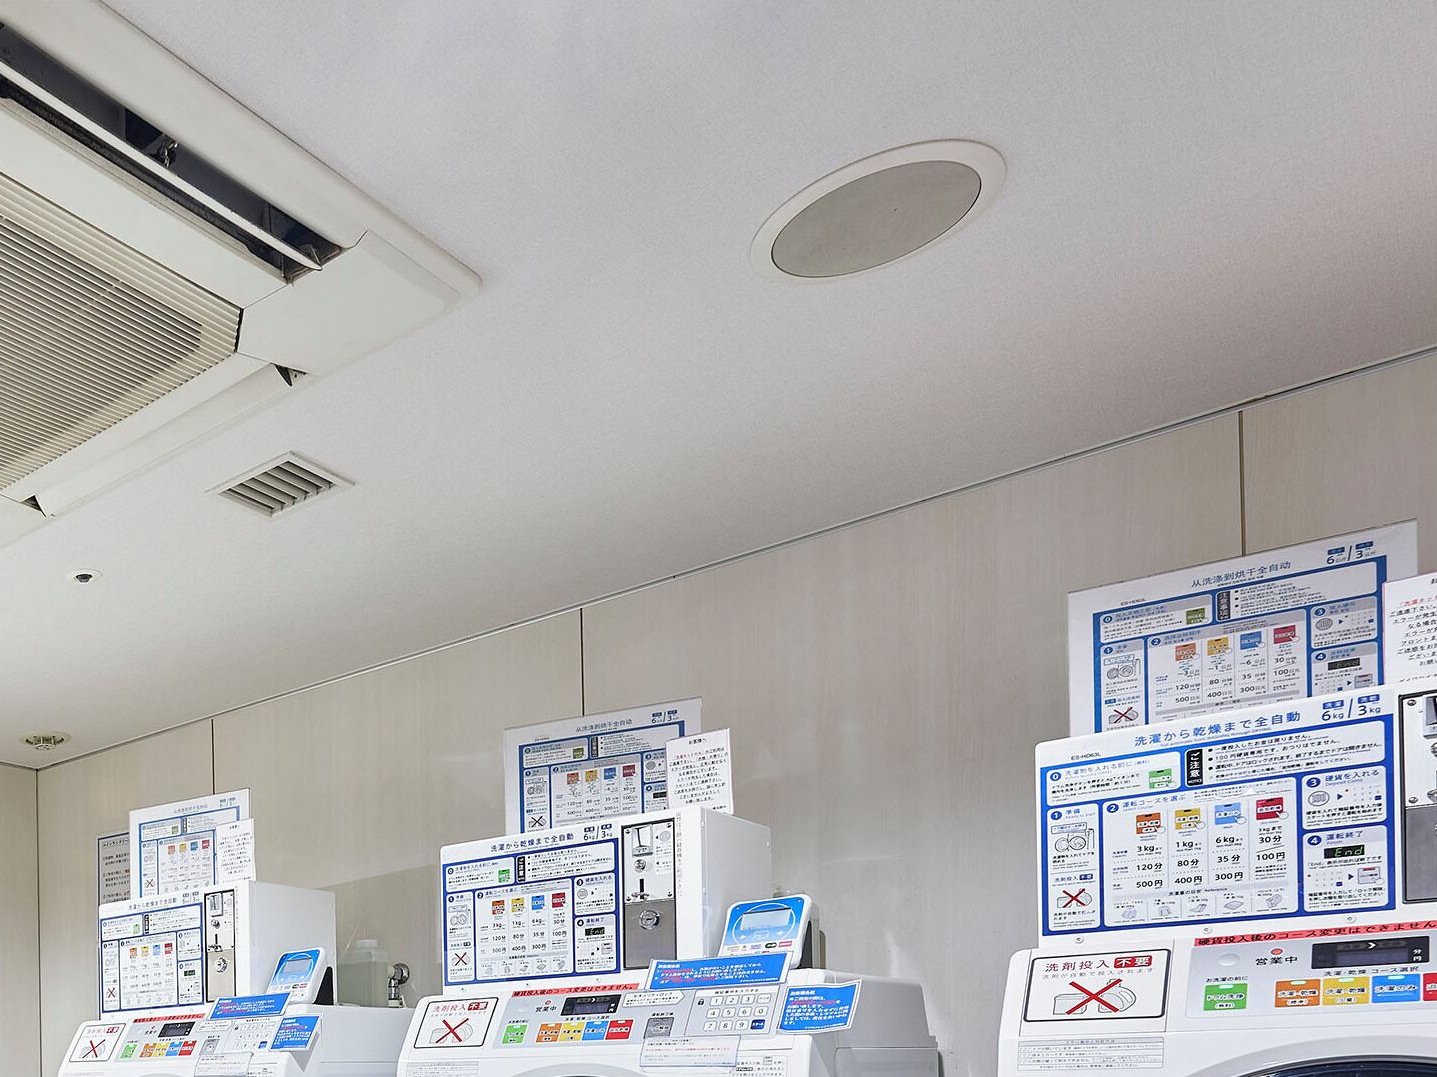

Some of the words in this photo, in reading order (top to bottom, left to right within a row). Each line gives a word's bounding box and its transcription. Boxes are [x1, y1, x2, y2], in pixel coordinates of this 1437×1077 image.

[1191, 560, 1291, 589] 从洗涤到烘干全自动
[1134, 711, 1301, 748] 洗濯から乾燥まで全自動
[1325, 769, 1380, 782] 硬貨を入れる
[1259, 835, 1282, 843] 30分
[1326, 831, 1363, 840] 運転終了
[491, 833, 574, 852] 洗濯から乾燥まで全自動
[1217, 855, 1241, 863] 35分
[1256, 852, 1285, 861] 100円
[1137, 862, 1163, 871] 120分
[1177, 859, 1199, 867] 80分
[1136, 879, 1163, 888] 500円
[1174, 875, 1202, 885] 400円
[1215, 872, 1243, 880] 300円
[1045, 960, 1110, 972] 洗剤投入
[1116, 957, 1151, 967] 不要
[1255, 956, 1298, 966] 営業中
